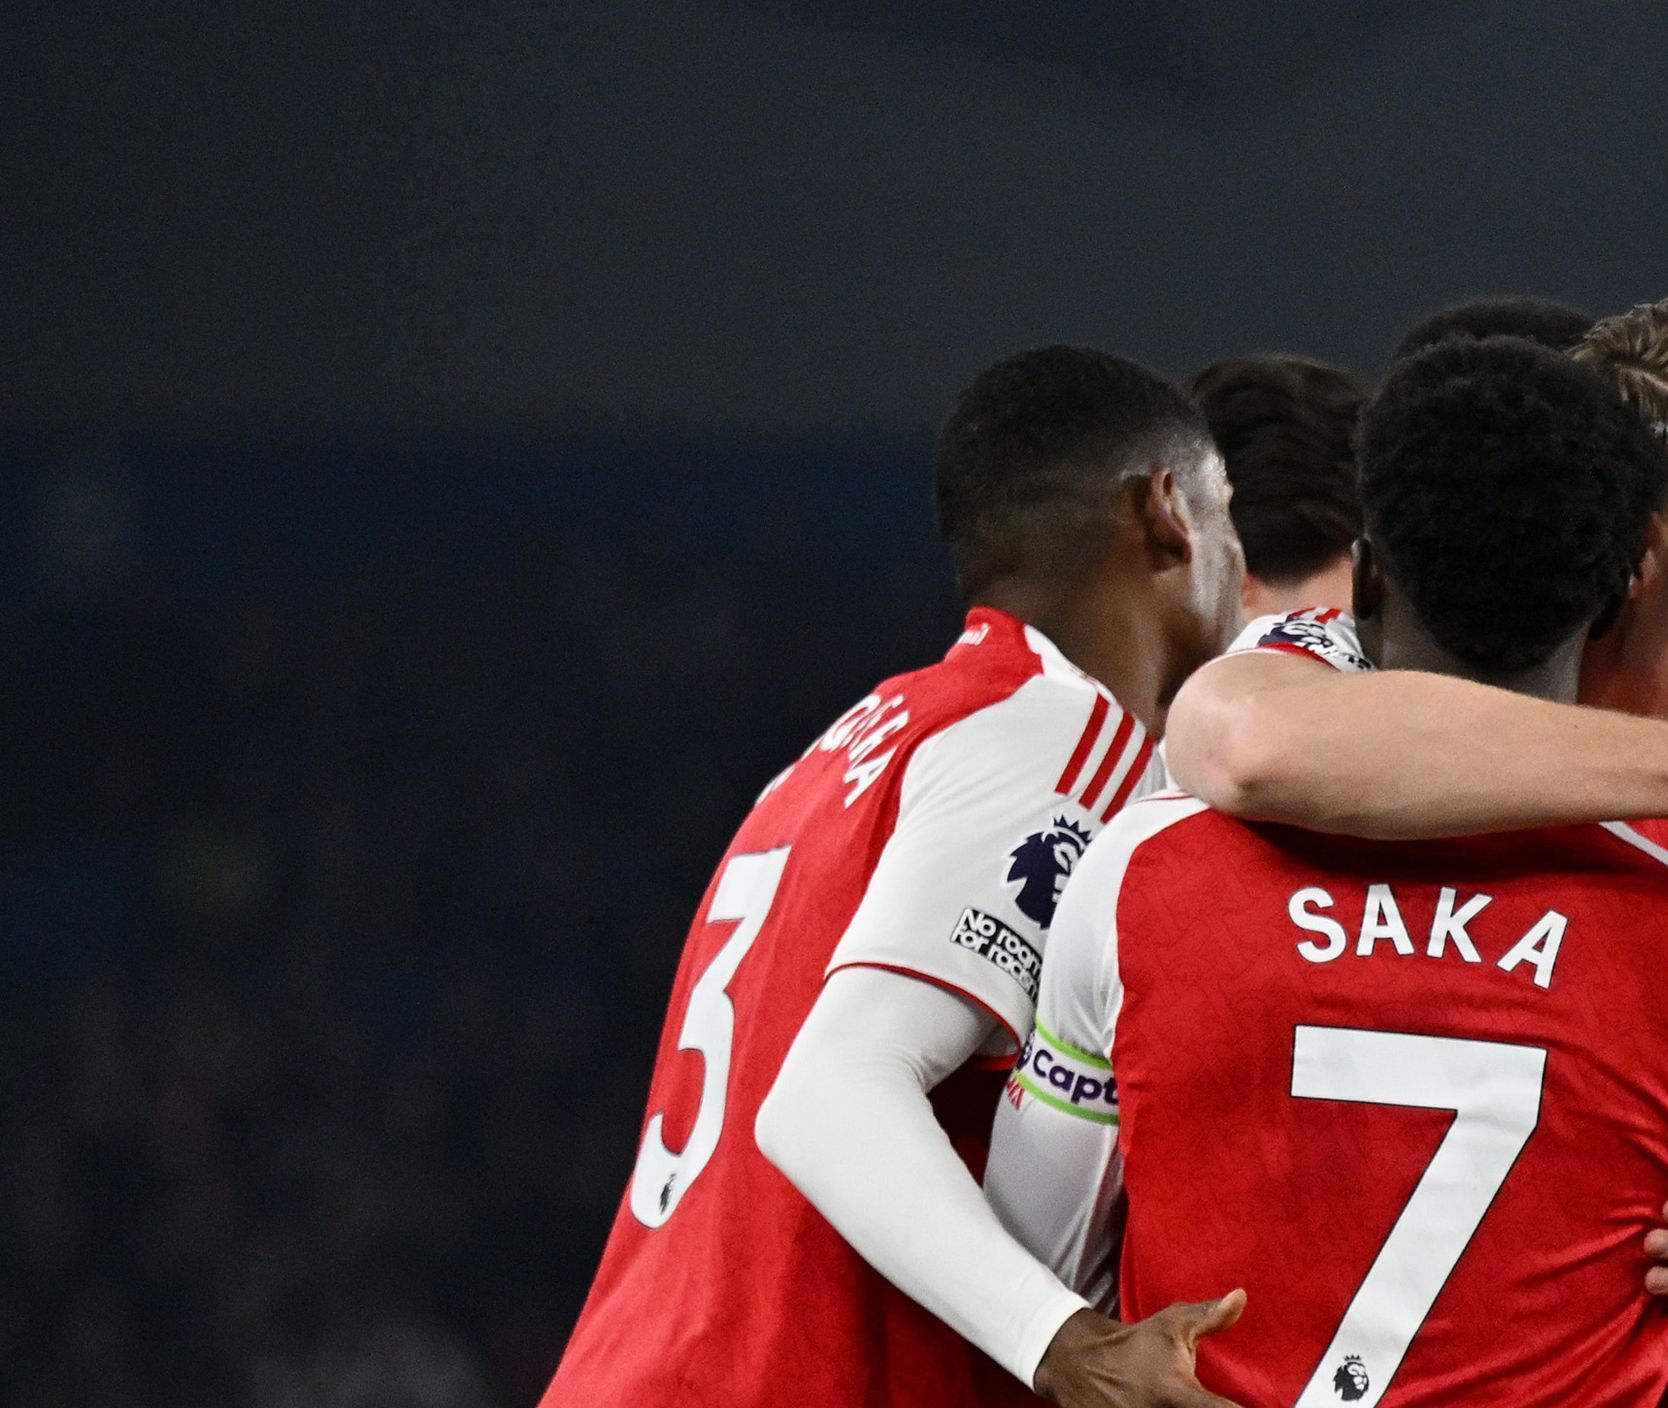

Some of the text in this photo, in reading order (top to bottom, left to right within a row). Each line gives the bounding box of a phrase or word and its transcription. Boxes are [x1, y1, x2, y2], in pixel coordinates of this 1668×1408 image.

[957, 908, 997, 938] No
[1288, 883, 1568, 990] SAKA
[630, 844, 792, 1230] 3
